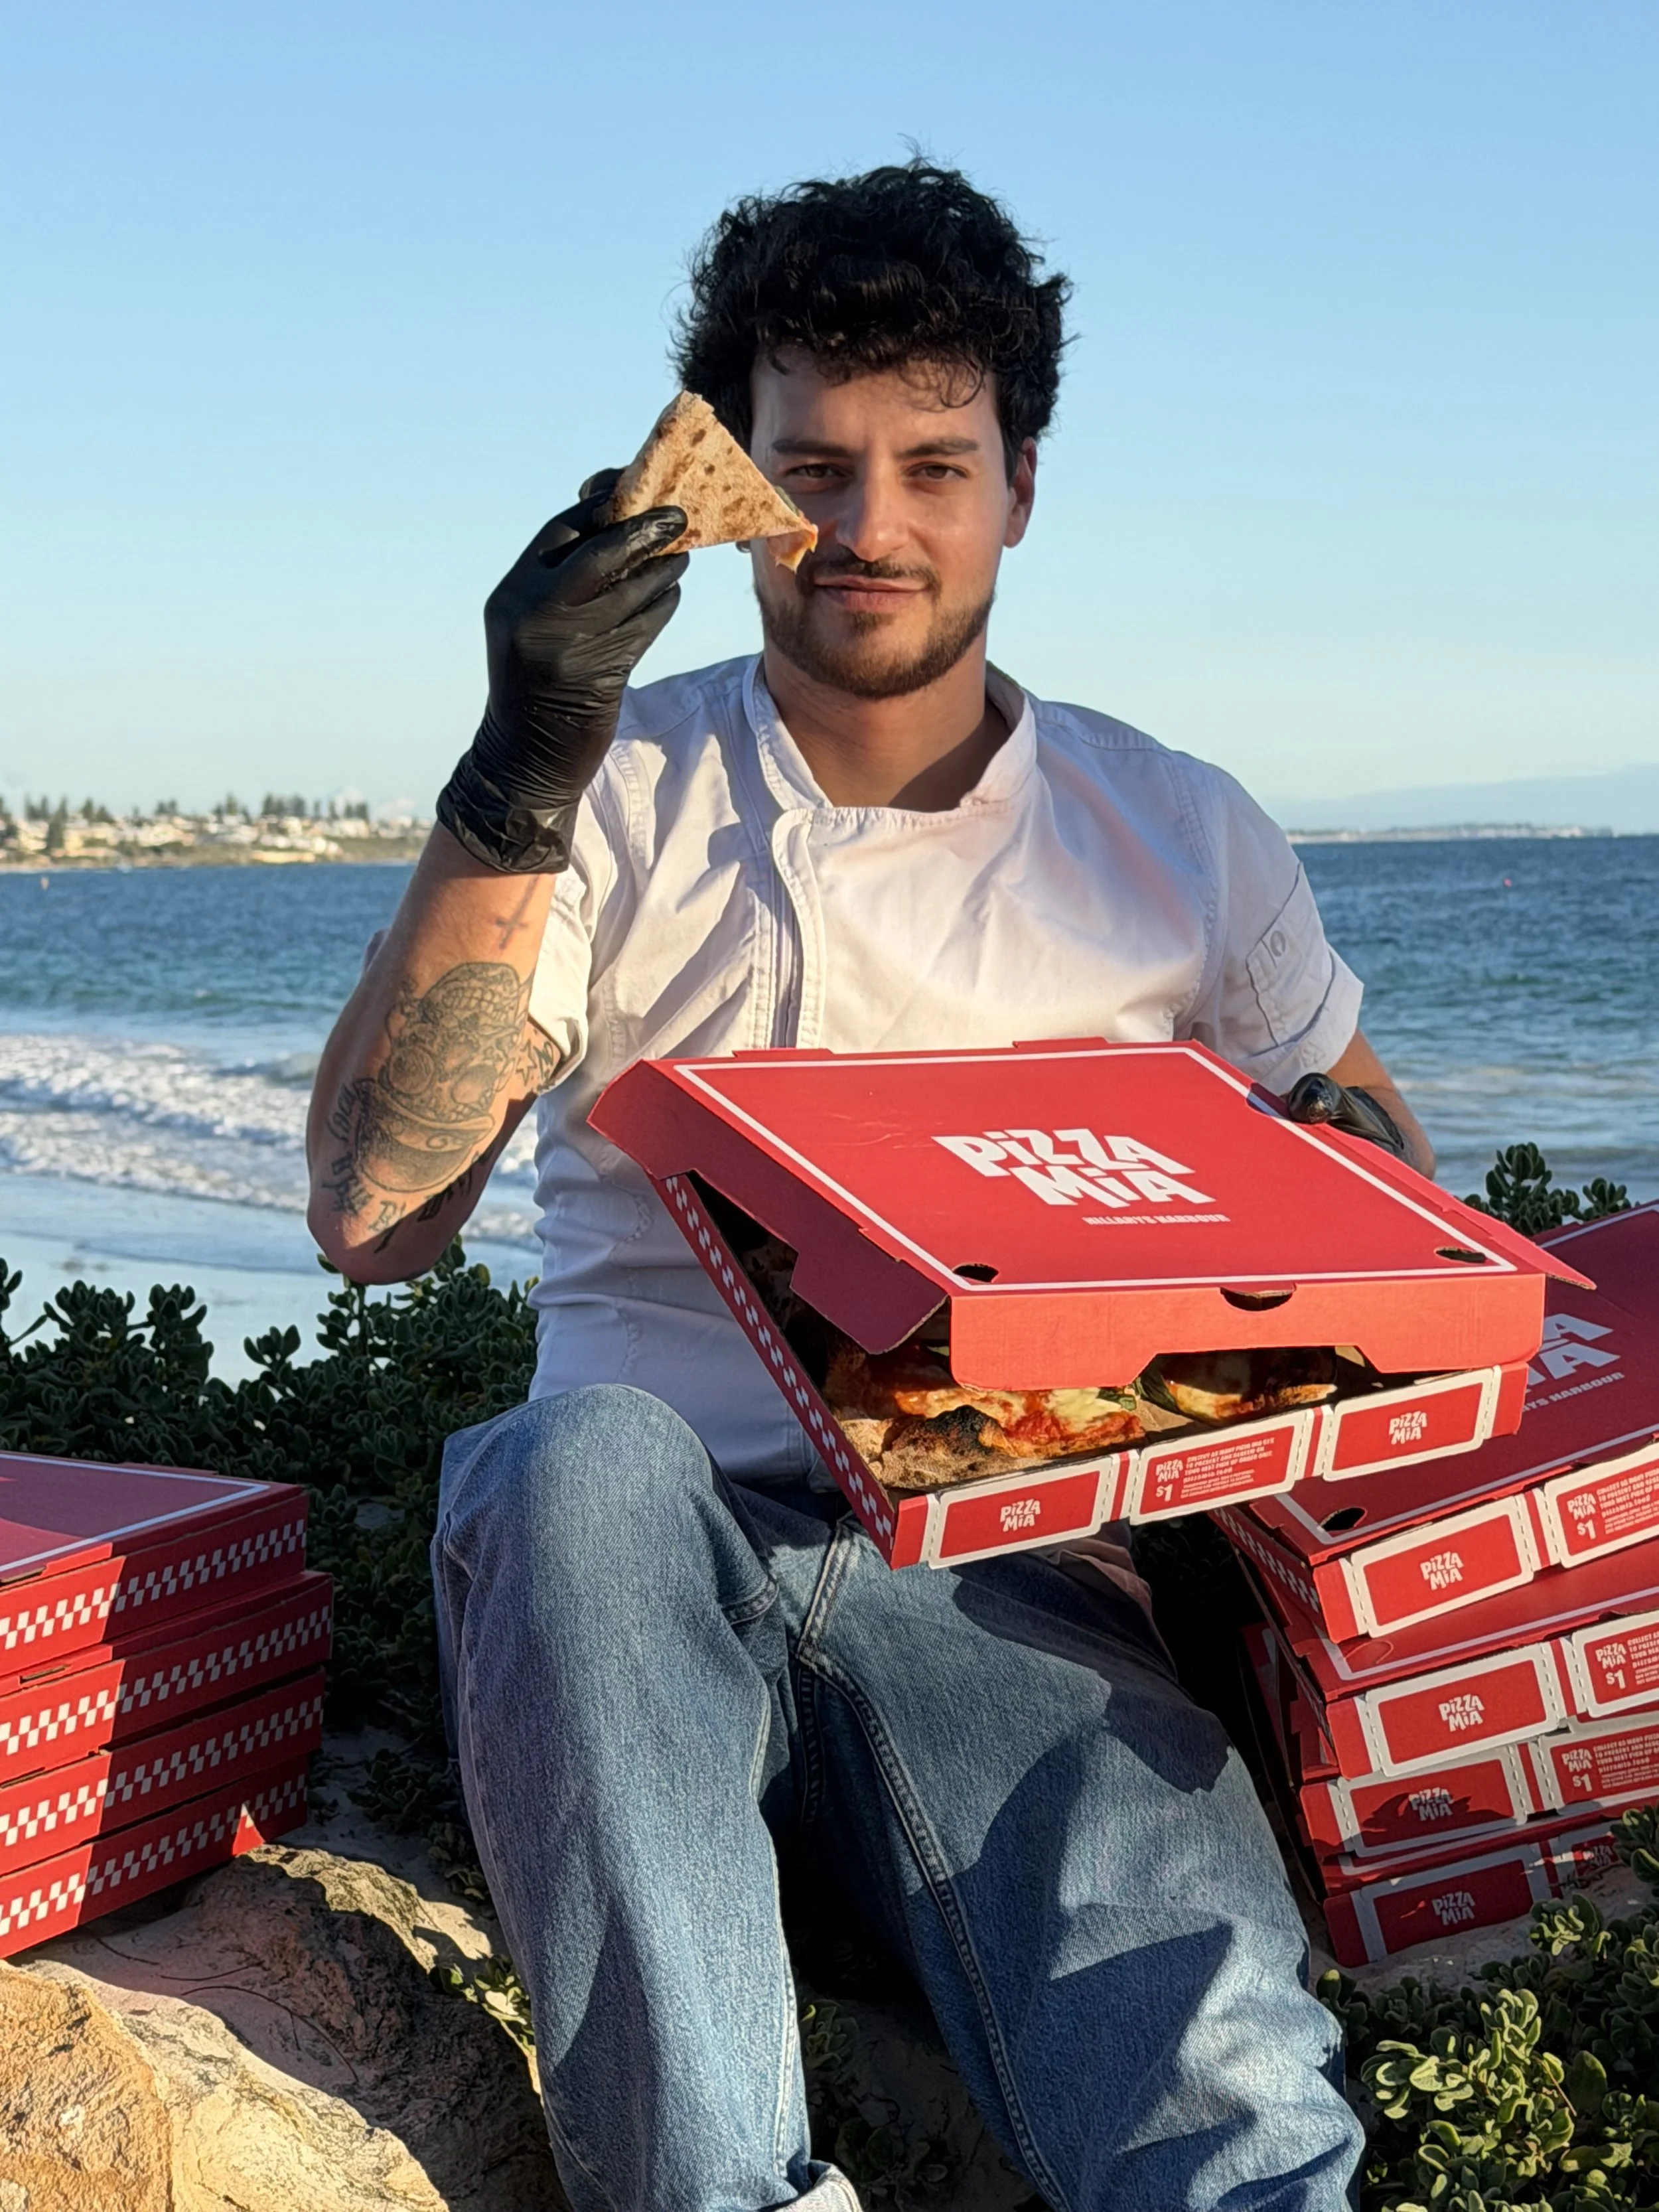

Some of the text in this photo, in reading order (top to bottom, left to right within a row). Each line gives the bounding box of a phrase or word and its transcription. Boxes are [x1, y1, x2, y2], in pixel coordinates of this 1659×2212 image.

[931, 1128, 1196, 1177] PiZZA
[1009, 1165, 1217, 1208] MiA
[1153, 1214, 1231, 1224] HARBOUR
[1549, 1372, 1625, 1402] HARBOUR
[1390, 1410, 1428, 1435] PiZZA
[1391, 1425, 1421, 1445] MiA
[1156, 1459, 1183, 1475] PiZZA
[1157, 1469, 1179, 1482] MiA
[1156, 1484, 1173, 1502] $1
[1567, 1493, 1596, 1513] PiZZA
[1000, 1499, 1041, 1522] PiZZA
[1573, 1504, 1596, 1520] MiA
[1003, 1514, 1035, 1532] MiA
[1577, 1520, 1596, 1540] $1
[1420, 1551, 1464, 1580] PiZZA
[1429, 1566, 1463, 1591] MiA
[1595, 1643, 1626, 1662] PiZZA
[1603, 1654, 1626, 1669] MiA
[1606, 1669, 1626, 1689] $1
[1439, 1694, 1484, 1722] PiZZA
[1448, 1710, 1484, 1732] MiA
[1561, 1748, 1593, 1765] PiZZA
[1569, 1759, 1592, 1773] MiA
[1572, 1773, 1592, 1792] $1
[1408, 1787, 1455, 1810] PiZZA
[1418, 1802, 1454, 1821] MiA
[1432, 1891, 1476, 1915] PiZZA
[1441, 1905, 1475, 1925] MiA
